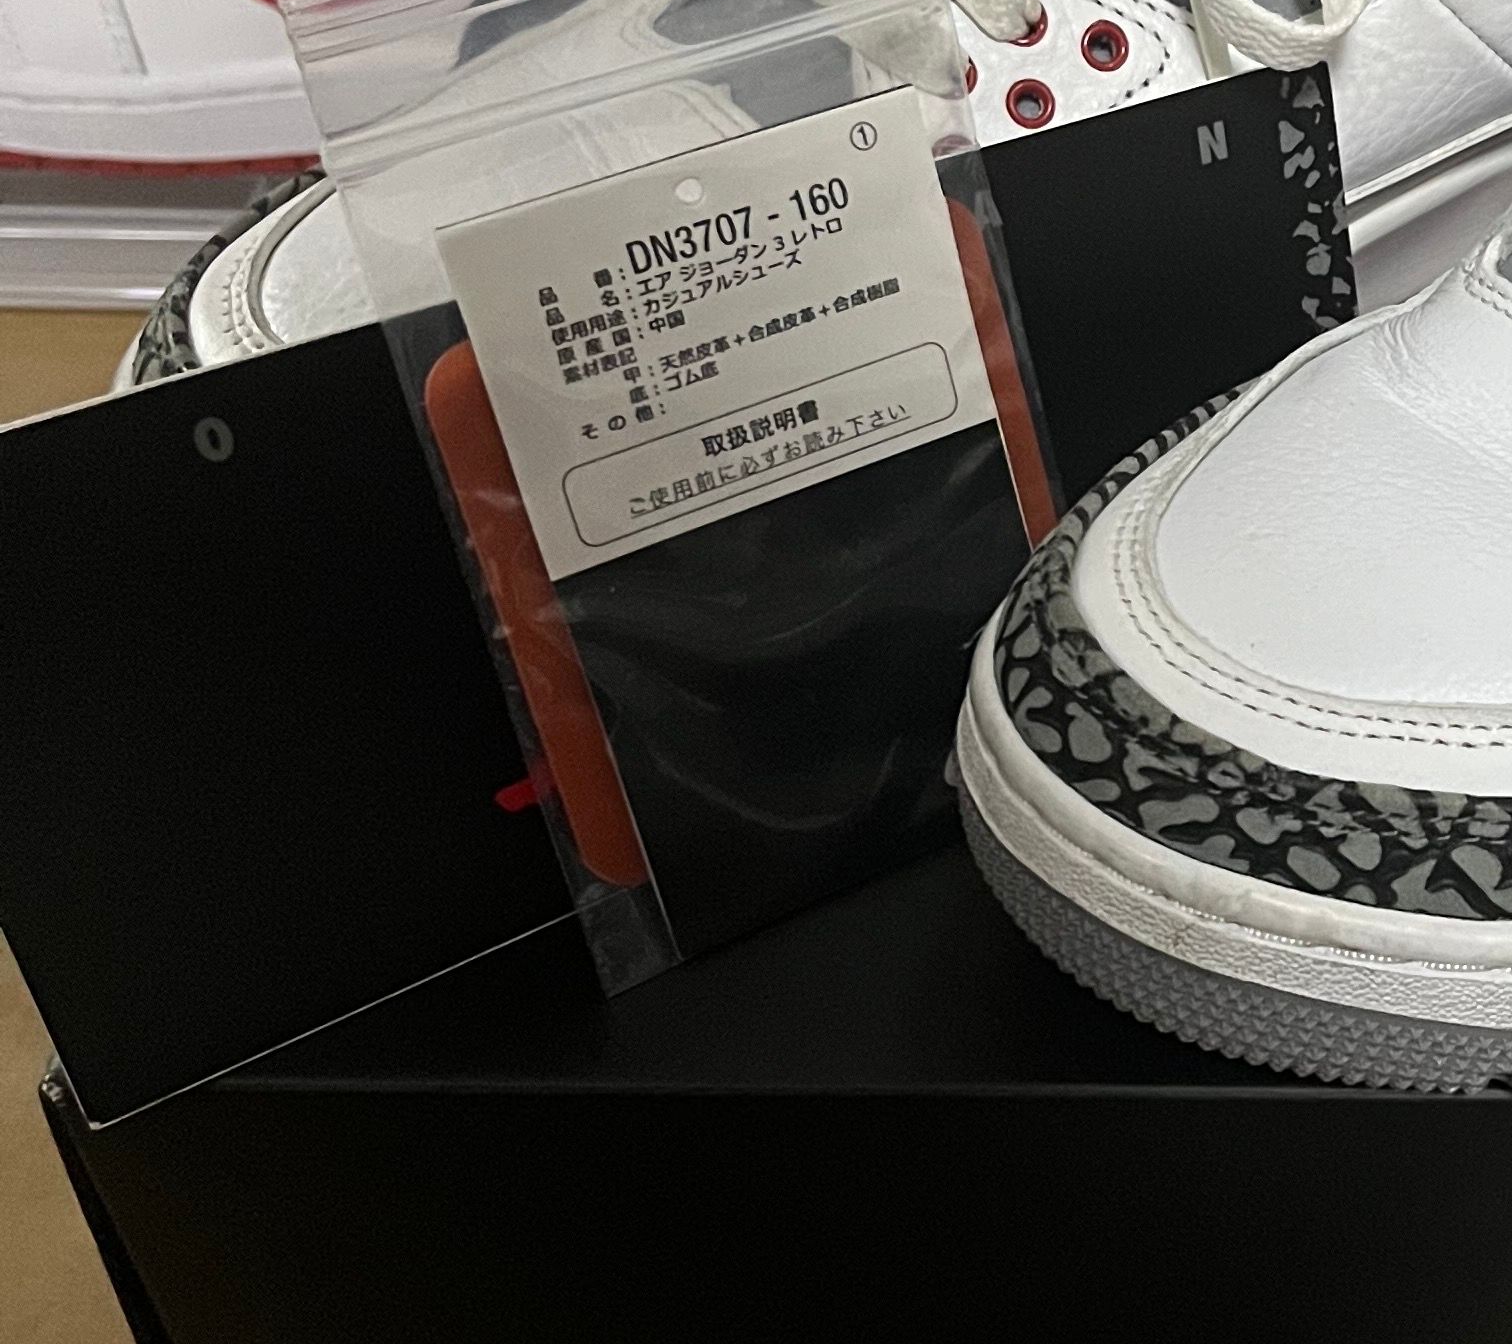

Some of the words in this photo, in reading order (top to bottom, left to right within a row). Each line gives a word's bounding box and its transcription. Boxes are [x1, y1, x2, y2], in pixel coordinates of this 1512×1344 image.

[1197, 120, 1229, 165] N
[625, 206, 752, 274] DN3707
[789, 177, 849, 220] 160
[628, 404, 908, 516] ご使用前に必ずお読み下さい
[701, 399, 820, 457] 取扱説明書
